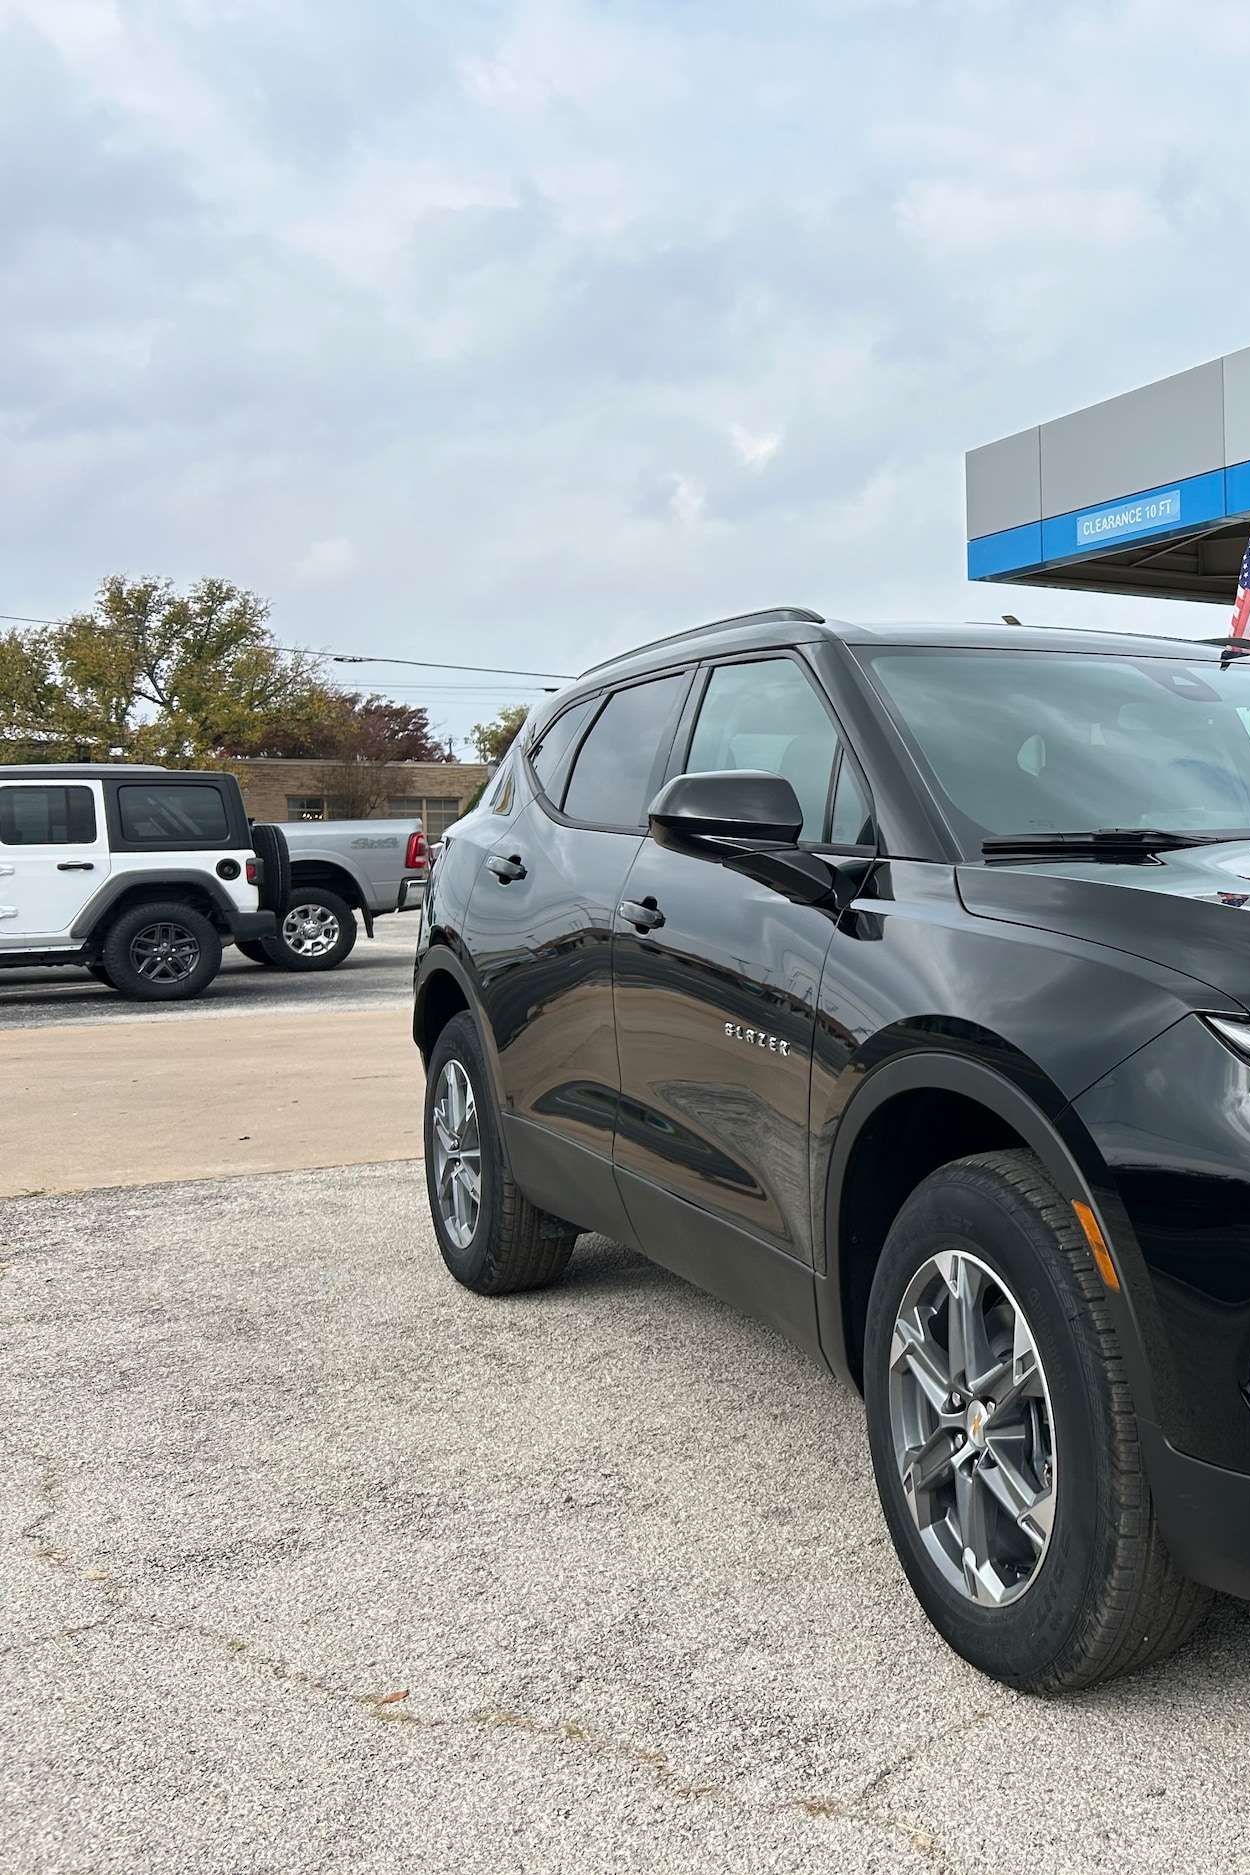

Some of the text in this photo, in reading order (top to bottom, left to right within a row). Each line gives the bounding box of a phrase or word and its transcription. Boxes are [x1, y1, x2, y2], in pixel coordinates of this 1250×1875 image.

[1083, 499, 1172, 536] CLEARANCE 10 FT
[724, 1022, 791, 1056] BLAZER
